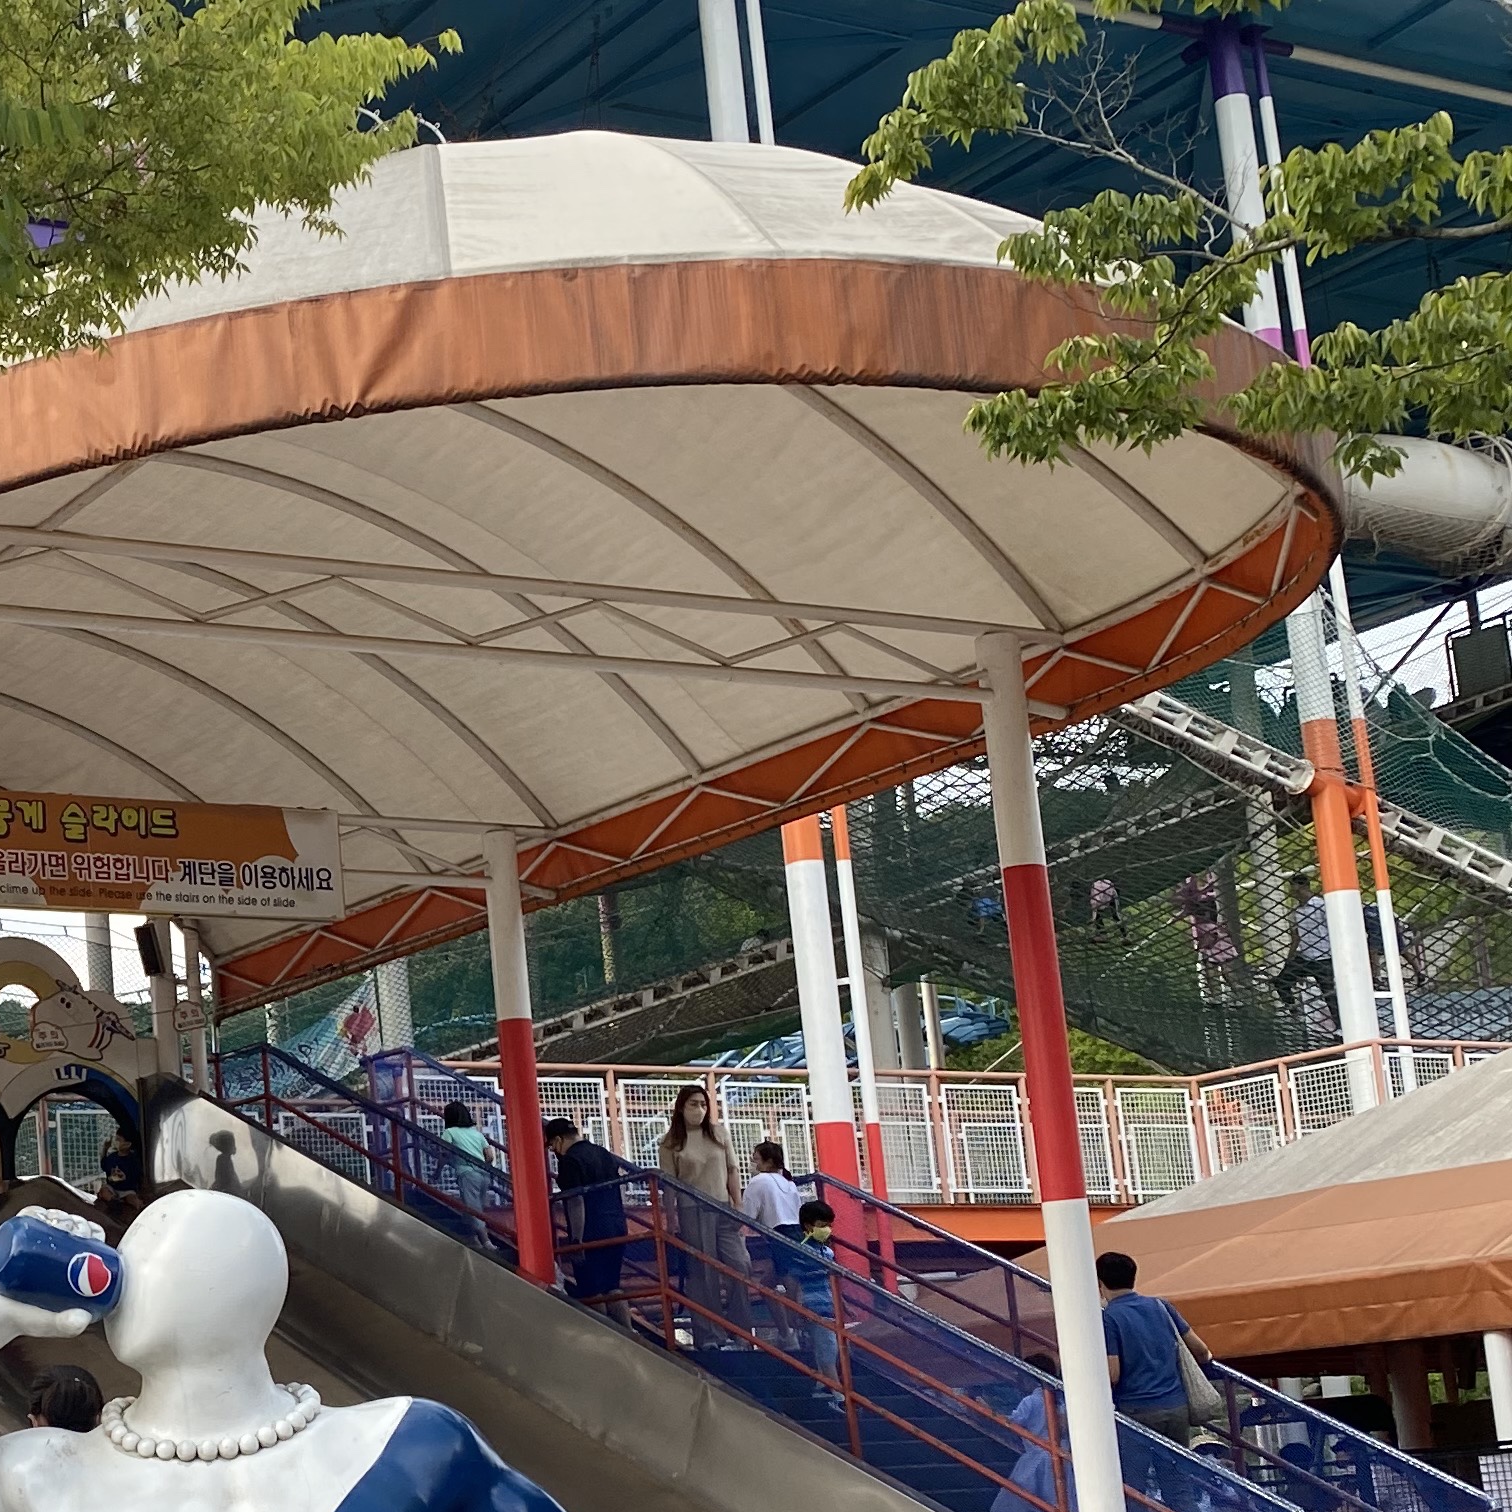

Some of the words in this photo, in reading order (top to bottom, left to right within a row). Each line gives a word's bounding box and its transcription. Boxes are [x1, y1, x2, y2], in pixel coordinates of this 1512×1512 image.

[60, 802, 178, 842] 슬라이드
[179, 859, 235, 888] 계단을
[241, 863, 334, 892] 이용하세요
[31, 886, 45, 896] up
[49, 885, 66, 896] the
[98, 887, 133, 899] Please
[135, 890, 153, 900] use
[155, 890, 173, 901] the
[174, 891, 200, 903] stairs
[202, 894, 216, 904] on
[218, 893, 235, 905] the
[237, 895, 258, 906] side
[260, 896, 271, 907] of
